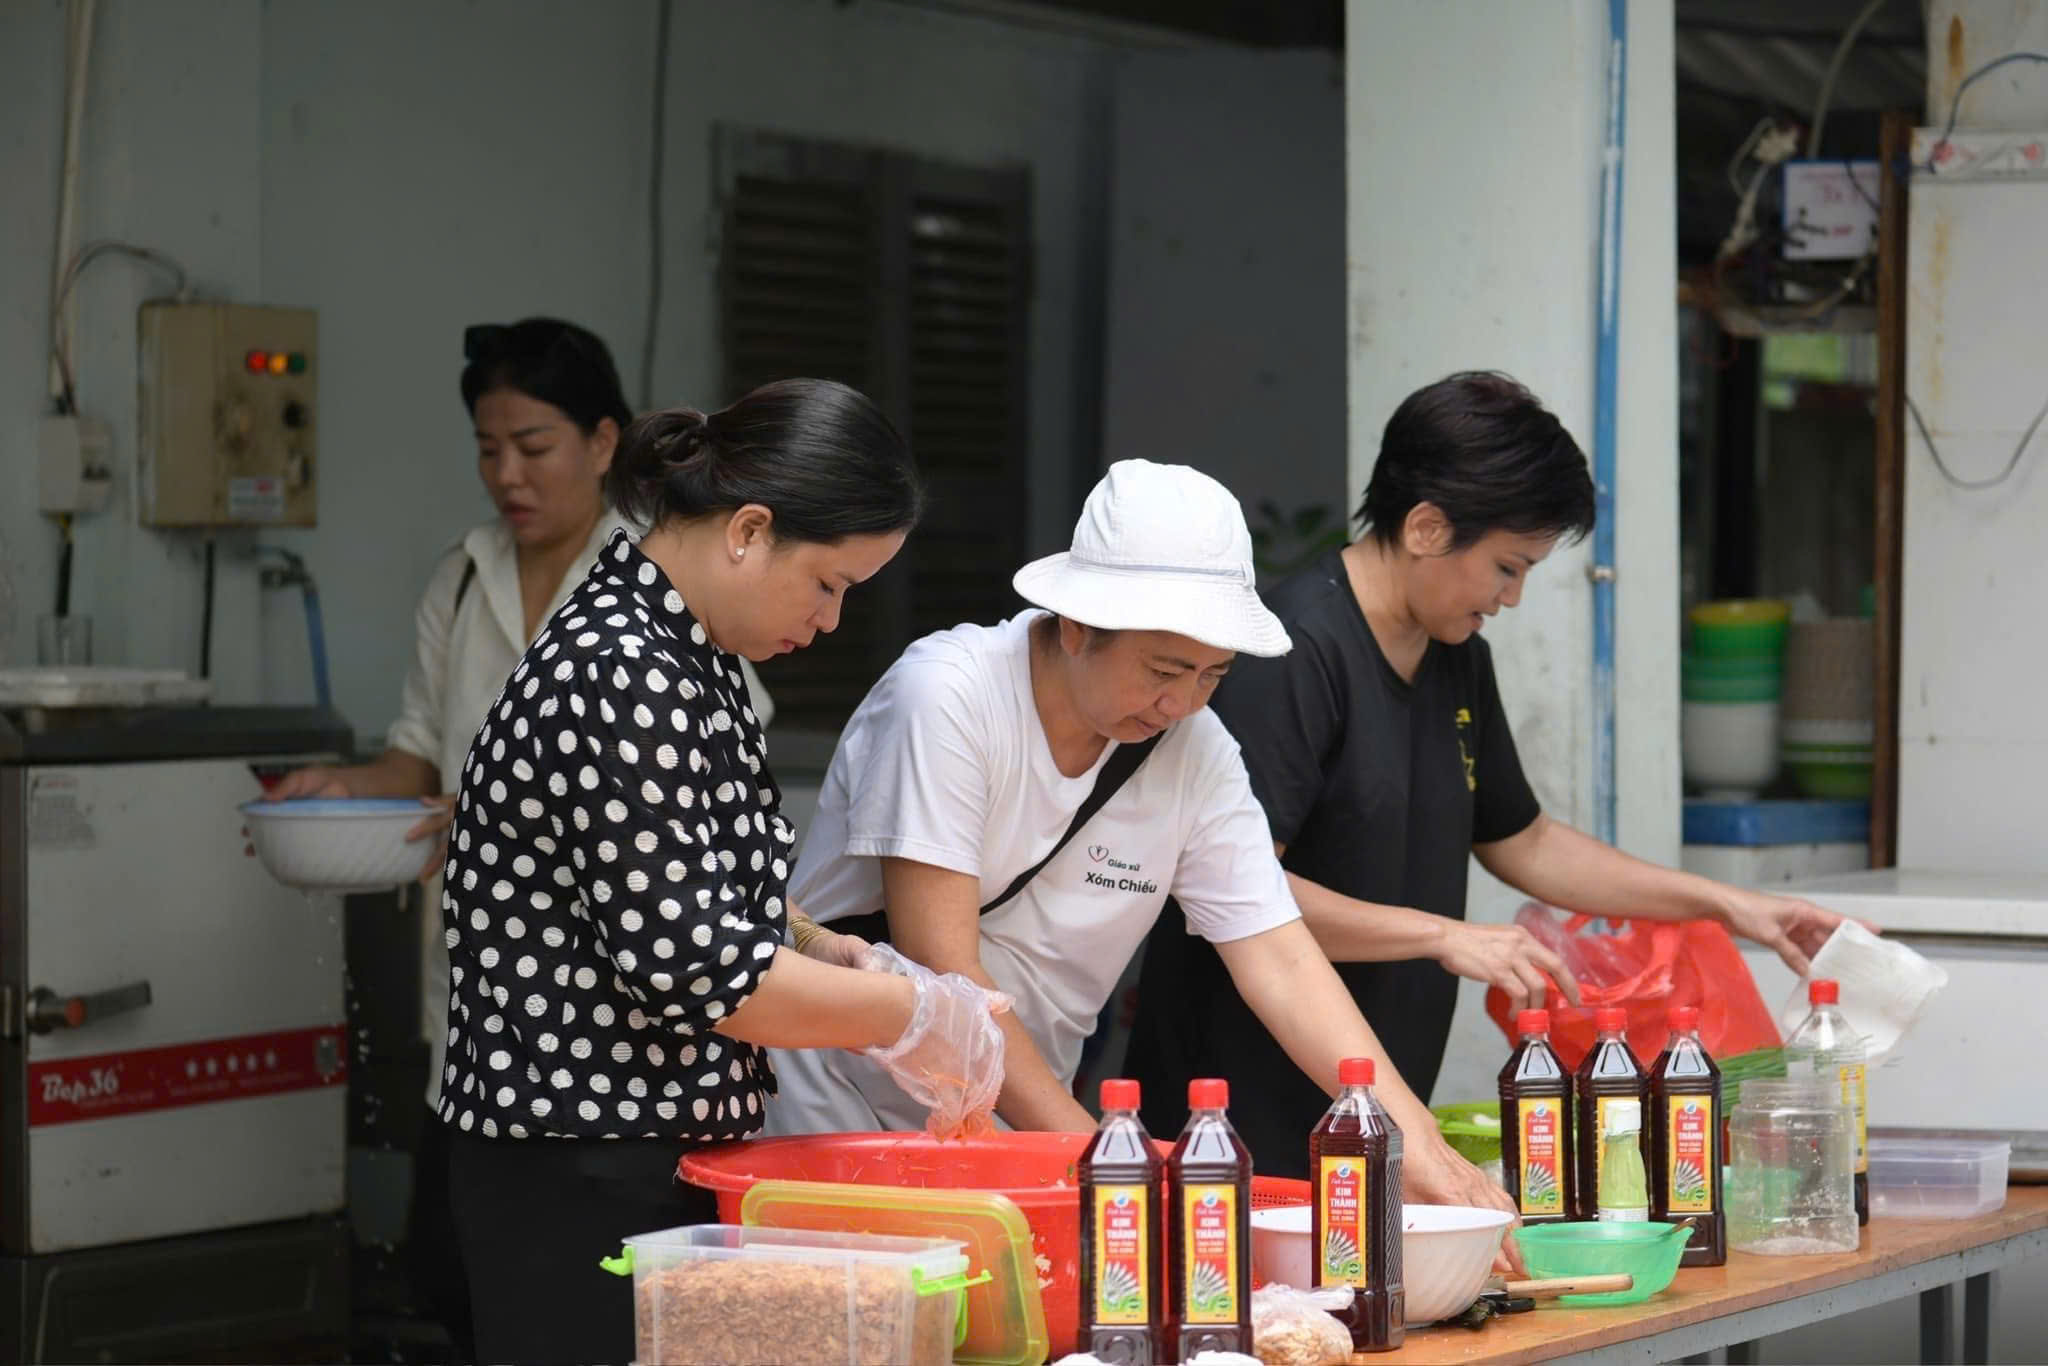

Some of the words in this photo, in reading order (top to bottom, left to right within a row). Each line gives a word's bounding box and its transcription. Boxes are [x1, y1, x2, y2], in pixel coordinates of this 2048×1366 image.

[1108, 859, 1127, 869] Giáo
[1085, 872, 1115, 888] Xóm
[1119, 879, 1158, 893] Chiếu
[1336, 1187, 1352, 1197] KIM
